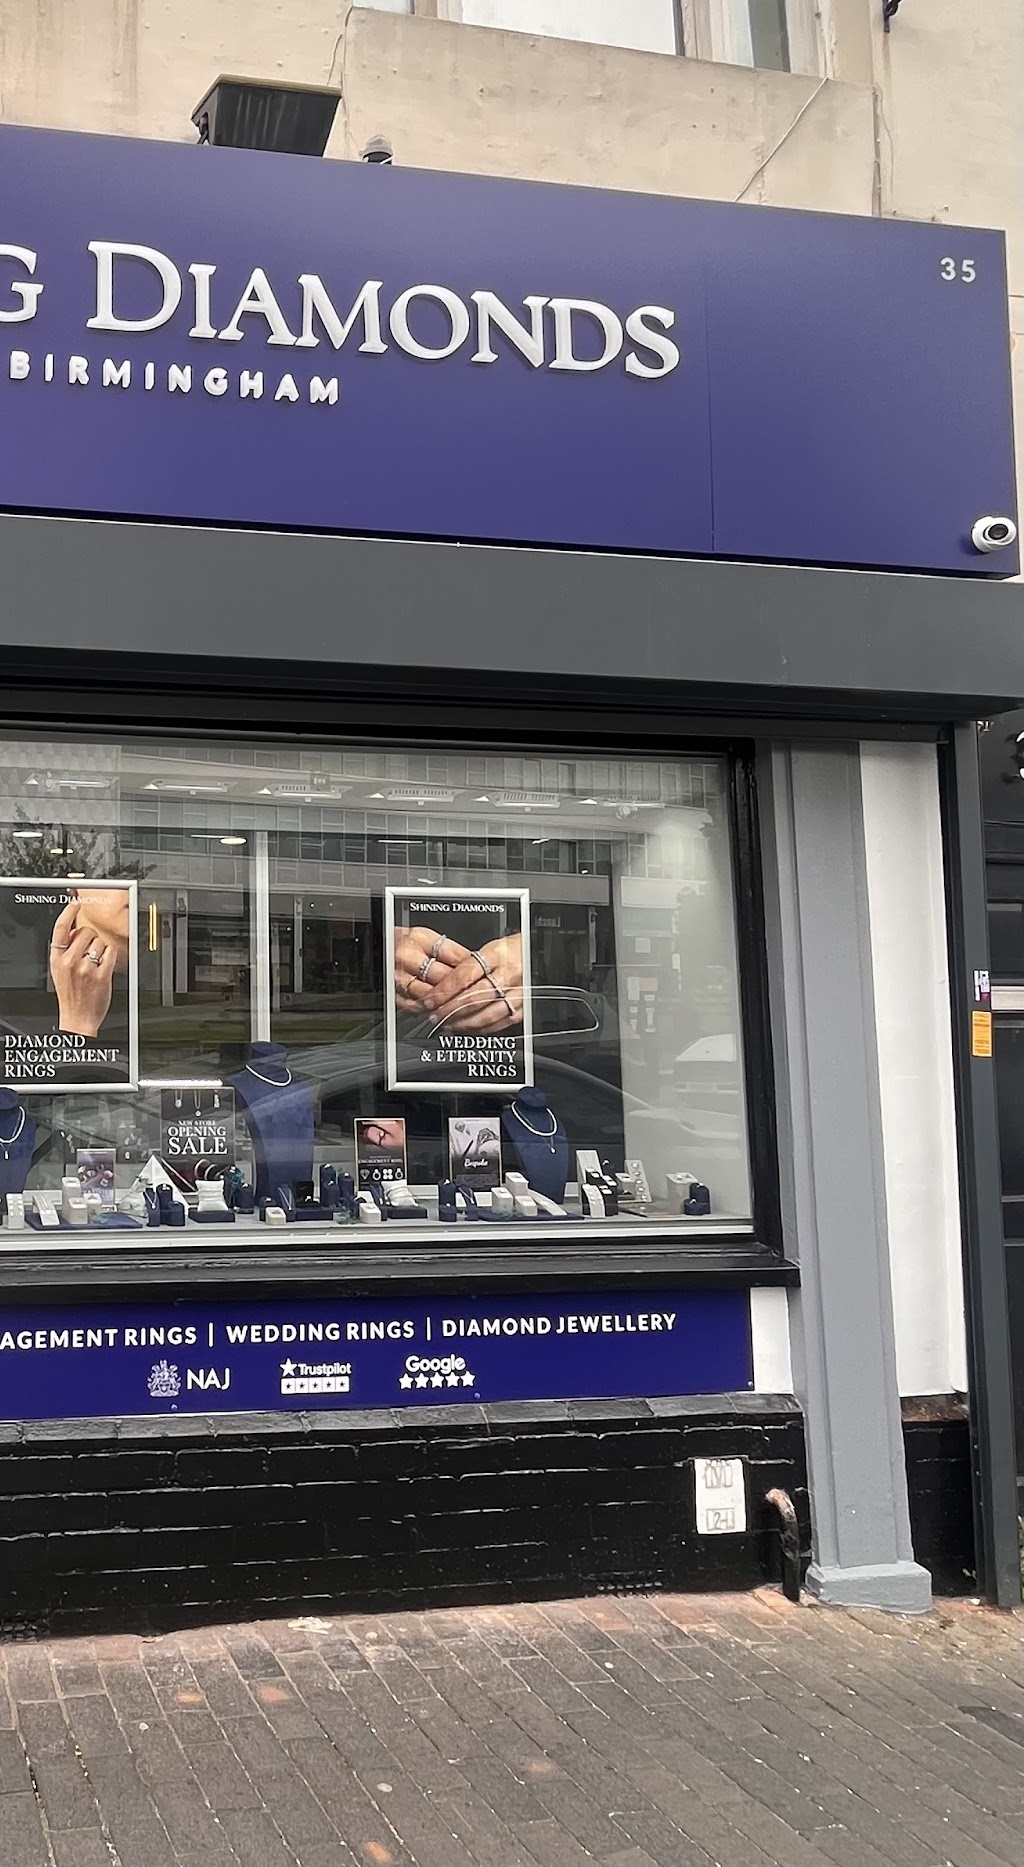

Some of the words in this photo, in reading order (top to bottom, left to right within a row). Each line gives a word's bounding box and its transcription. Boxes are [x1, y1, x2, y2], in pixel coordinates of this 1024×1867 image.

[940, 257, 976, 283] 35
[85, 240, 680, 379] DIAMONDS
[9, 350, 340, 405] BIRMINGHAM
[4, 1035, 86, 1048] DIAMOND
[439, 1036, 516, 1049] WEDDING
[4, 1049, 120, 1063] ENGAGEMENT
[420, 1050, 432, 1062] &
[436, 1050, 516, 1064] ETERNITY
[4, 1064, 56, 1078] RINGS
[467, 1065, 517, 1077] RINGS
[167, 1126, 227, 1137] OPENING
[168, 1136, 228, 1155] SALE
[124, 1326, 197, 1347] RINGS
[226, 1322, 340, 1343] WEDDING
[346, 1320, 415, 1341] RINGS
[442, 1317, 552, 1338] DIAMOND
[556, 1313, 677, 1334] JEWELLERY
[298, 1363, 352, 1377] Trustpilot
[405, 1354, 466, 1374] Google
[186, 1368, 230, 1391] NAJ
